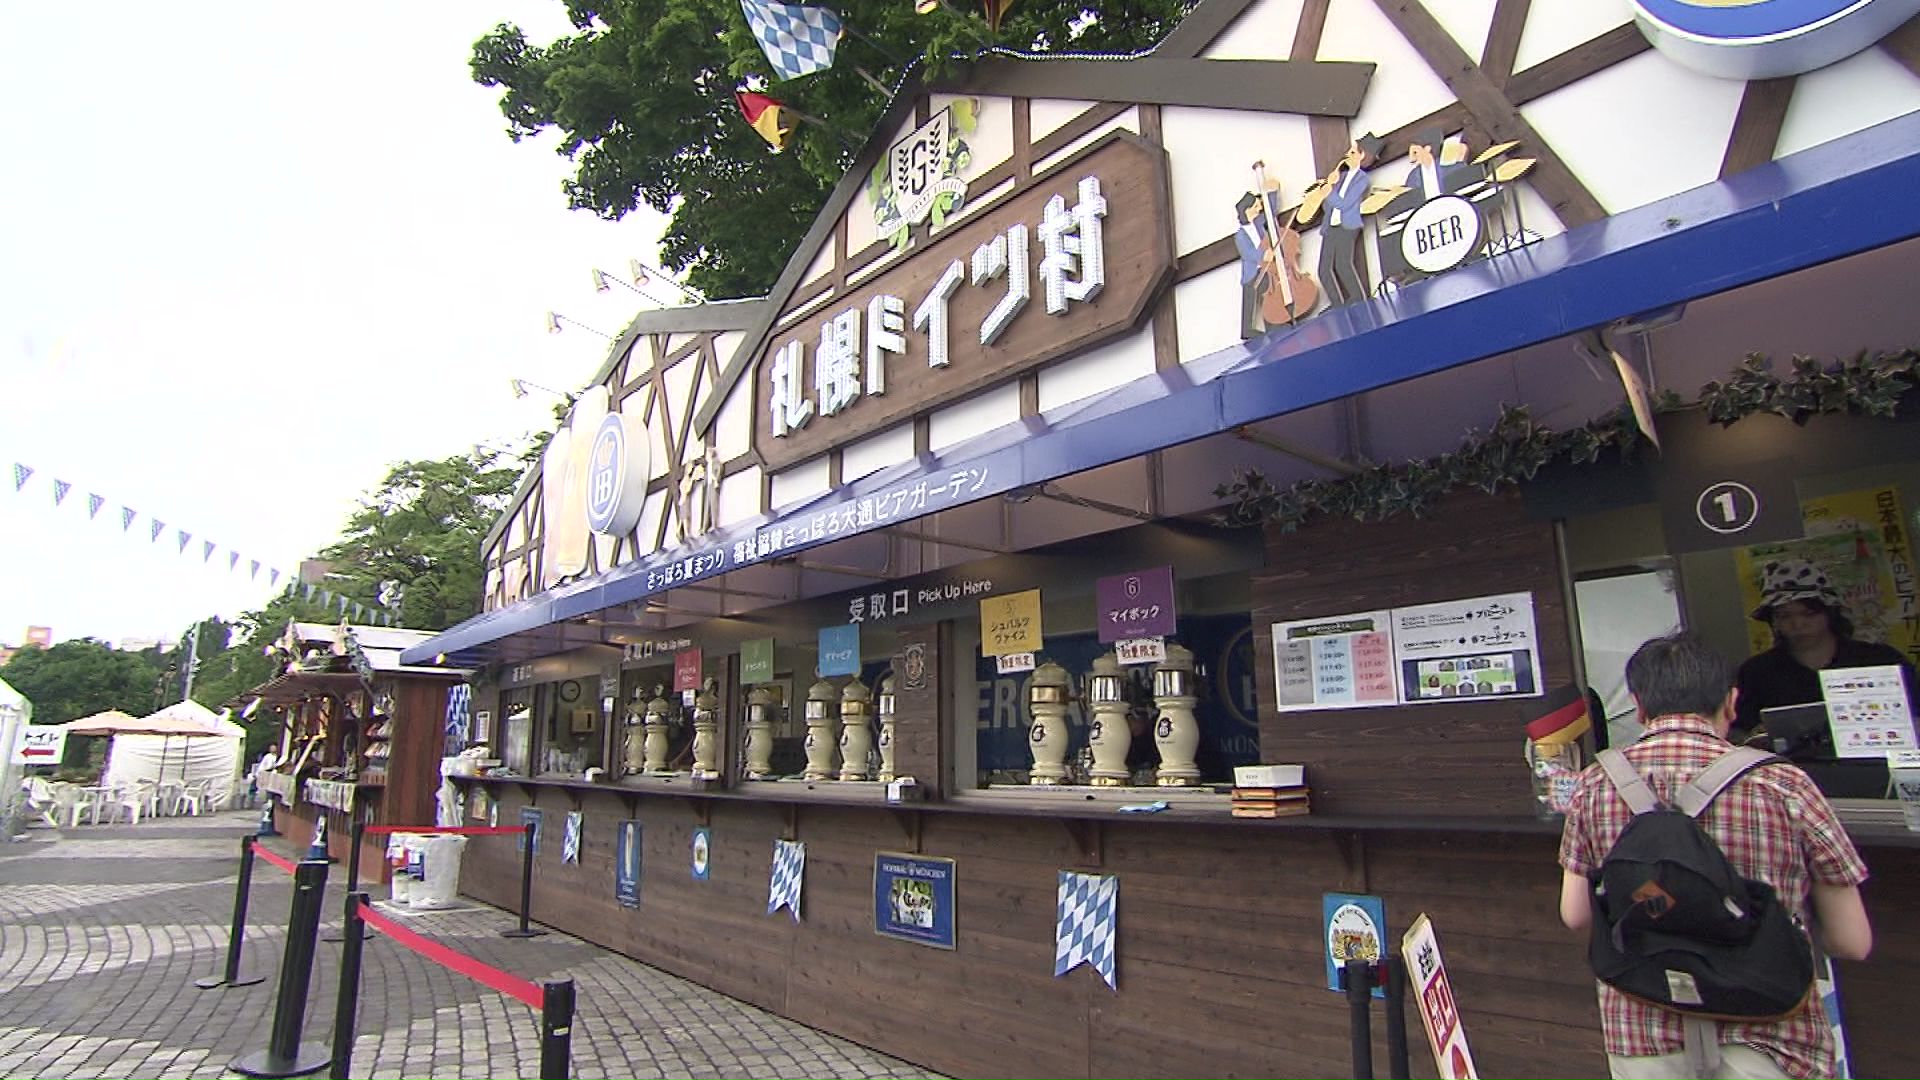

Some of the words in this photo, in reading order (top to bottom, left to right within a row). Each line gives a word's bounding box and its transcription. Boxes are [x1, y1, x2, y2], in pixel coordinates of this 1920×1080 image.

[1415, 214, 1463, 255] BEER
[770, 175, 1107, 438] 札幌ドイツ村
[648, 549, 725, 590] さっぽろ夏まつり
[849, 588, 909, 624] 受取口
[918, 588, 943, 605] Pick
[944, 584, 960, 601] Up
[963, 580, 992, 596] Here
[1109, 604, 1161, 624] マイボック
